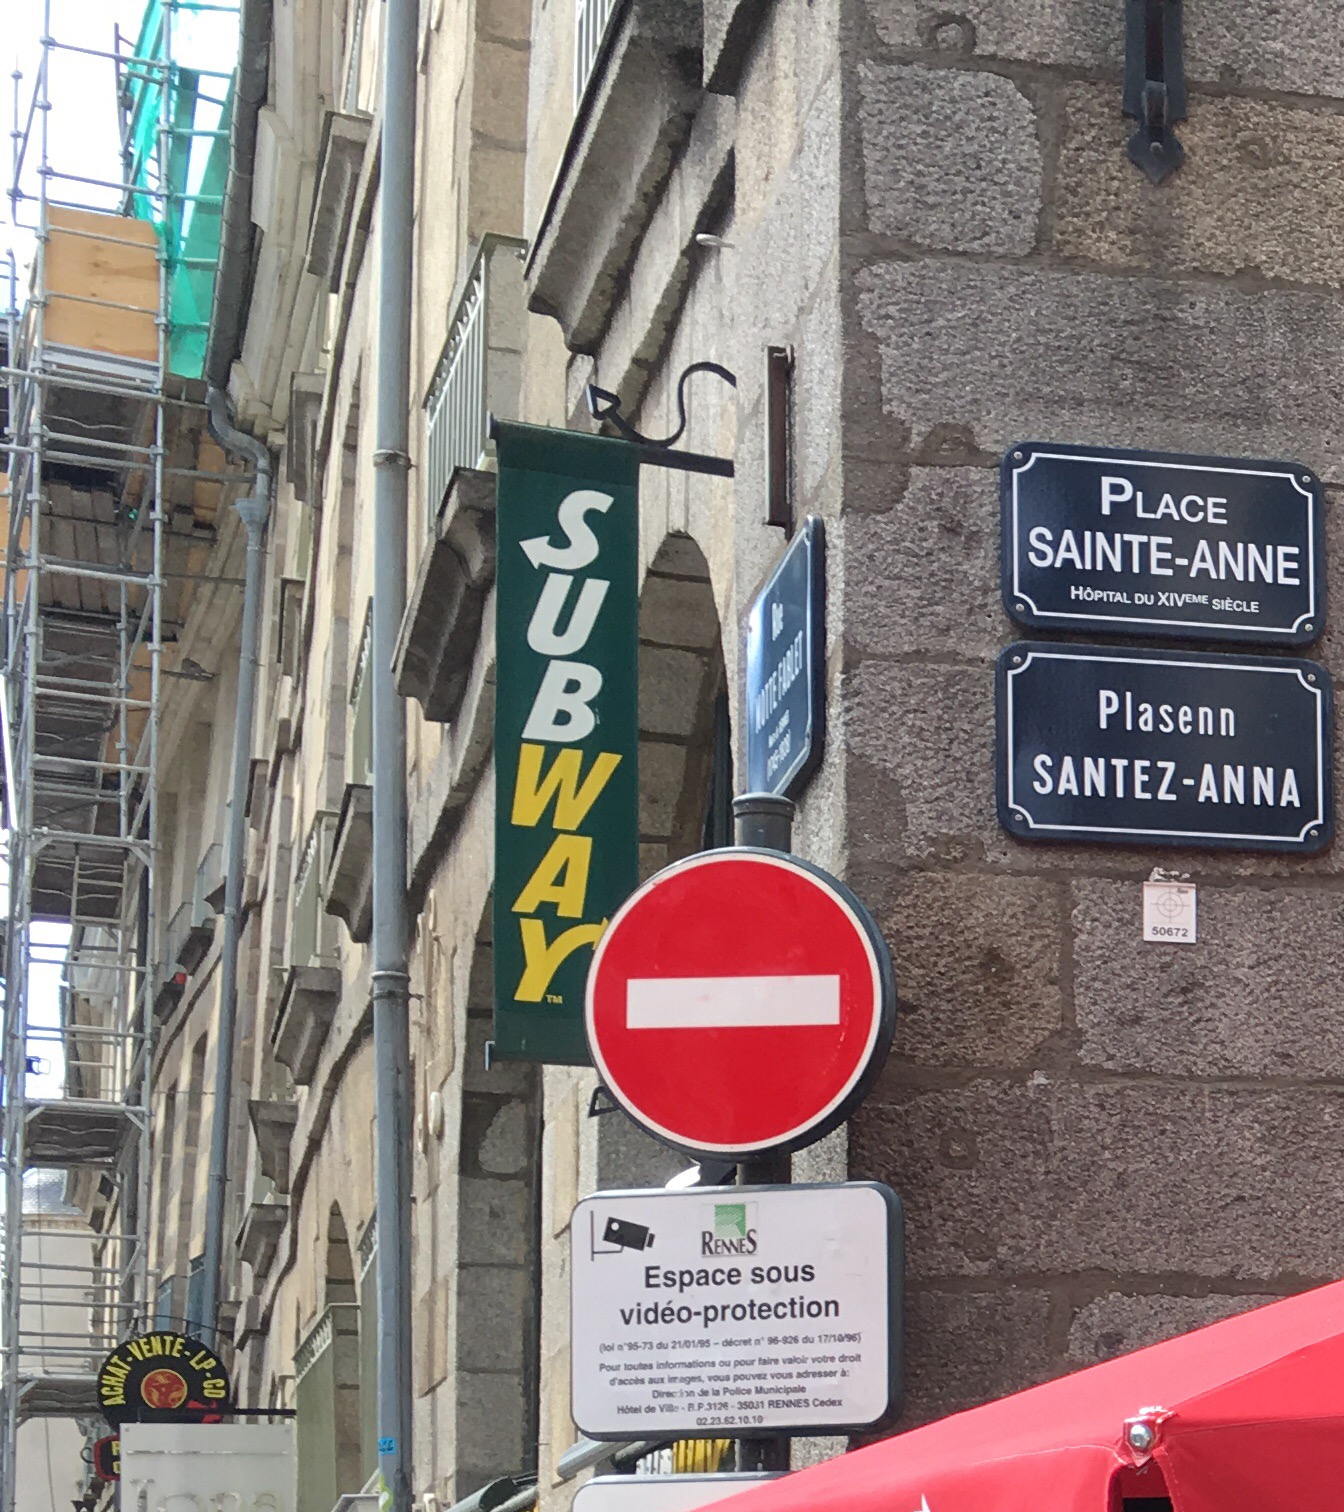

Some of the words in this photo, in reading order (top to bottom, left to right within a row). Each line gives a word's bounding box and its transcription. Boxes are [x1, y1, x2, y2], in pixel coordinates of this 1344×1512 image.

[1101, 476, 1228, 525] PLACE
[1027, 526, 1301, 586] SAINTE-ANNE
[1070, 585, 1131, 604] HÔPITAL
[1134, 592, 1155, 606] DU
[1212, 597, 1260, 613] SIÈCLE
[1099, 689, 1236, 737] Plasenn
[1033, 754, 1300, 807] SANTEZ-ANNA
[1152, 926, 1189, 938] 50672
[702, 1229, 757, 1255] RENNES
[644, 1266, 742, 1293] Espace
[751, 1263, 816, 1285] sous
[620, 1296, 840, 1328] vidéo-protection
[126, 1335, 186, 1361] VENTE
[656, 1341, 669, 1350] du
[671, 1339, 711, 1349] 21/01/95
[721, 1338, 752, 1347] décret
[802, 1335, 815, 1344] du
[188, 1350, 217, 1371] LP
[599, 1362, 621, 1372] Pour
[624, 1362, 653, 1371] toutes
[656, 1360, 716, 1370] informations
[718, 1359, 731, 1368] ou
[733, 1358, 756, 1369] pour
[758, 1357, 779, 1366] faire
[782, 1355, 809, 1365] valoir
[811, 1355, 836, 1364] votre
[838, 1353, 862, 1363] droit
[101, 1355, 131, 1406] ACHAT
[202, 1378, 226, 1398] CD
[609, 1376, 645, 1386] d'accès
[648, 1376, 665, 1385] aux
[707, 1374, 731, 1382] vous
[733, 1373, 767, 1383] pouvez
[770, 1372, 793, 1380] vous
[795, 1369, 838, 1379] adresser
[711, 1387, 720, 1396] la
[722, 1386, 752, 1396] Police
[754, 1384, 807, 1395] Municipale
[616, 1405, 642, 1414] Hôtel
[644, 1405, 656, 1413] de
[767, 1399, 810, 1409] RENNES
[812, 1398, 843, 1407] Cedex
